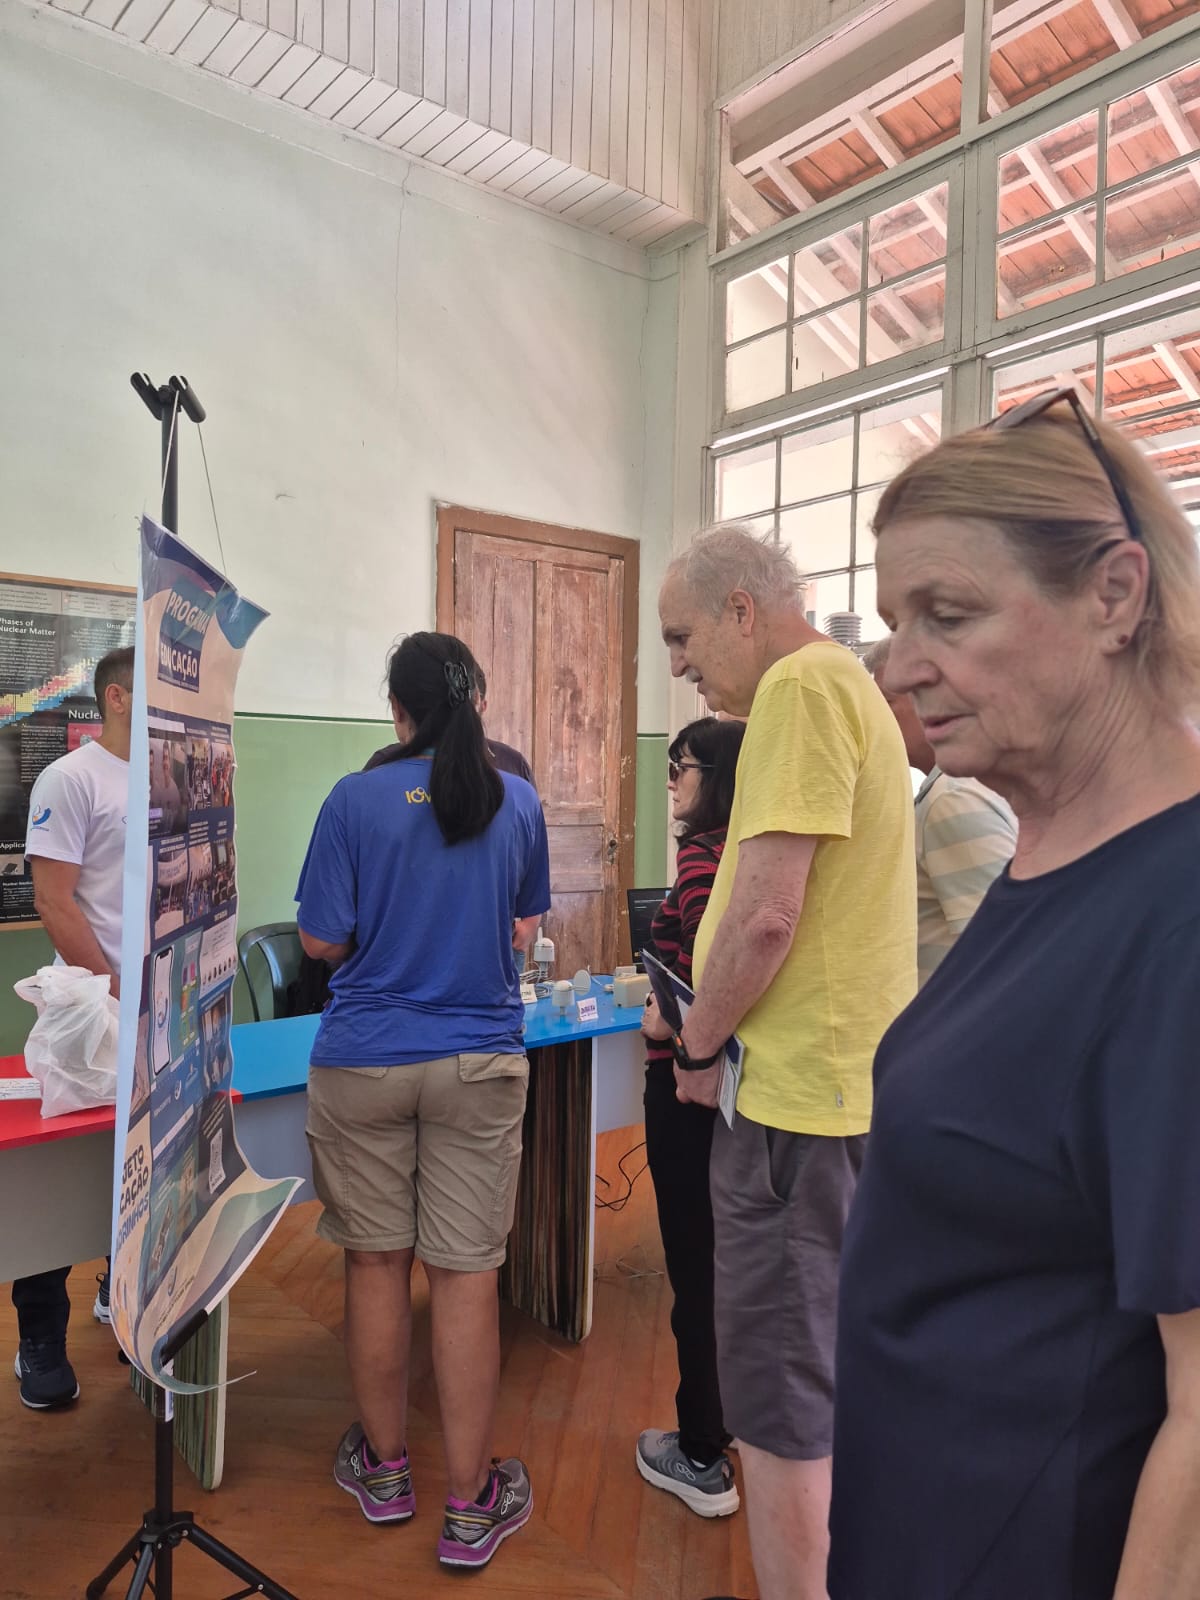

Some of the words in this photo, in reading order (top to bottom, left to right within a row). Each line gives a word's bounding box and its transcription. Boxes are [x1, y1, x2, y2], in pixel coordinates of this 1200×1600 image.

[29, 628, 56, 636] Matter
[160, 642, 198, 680] EDUCAÇÃO
[68, 709, 102, 720] Nucle
